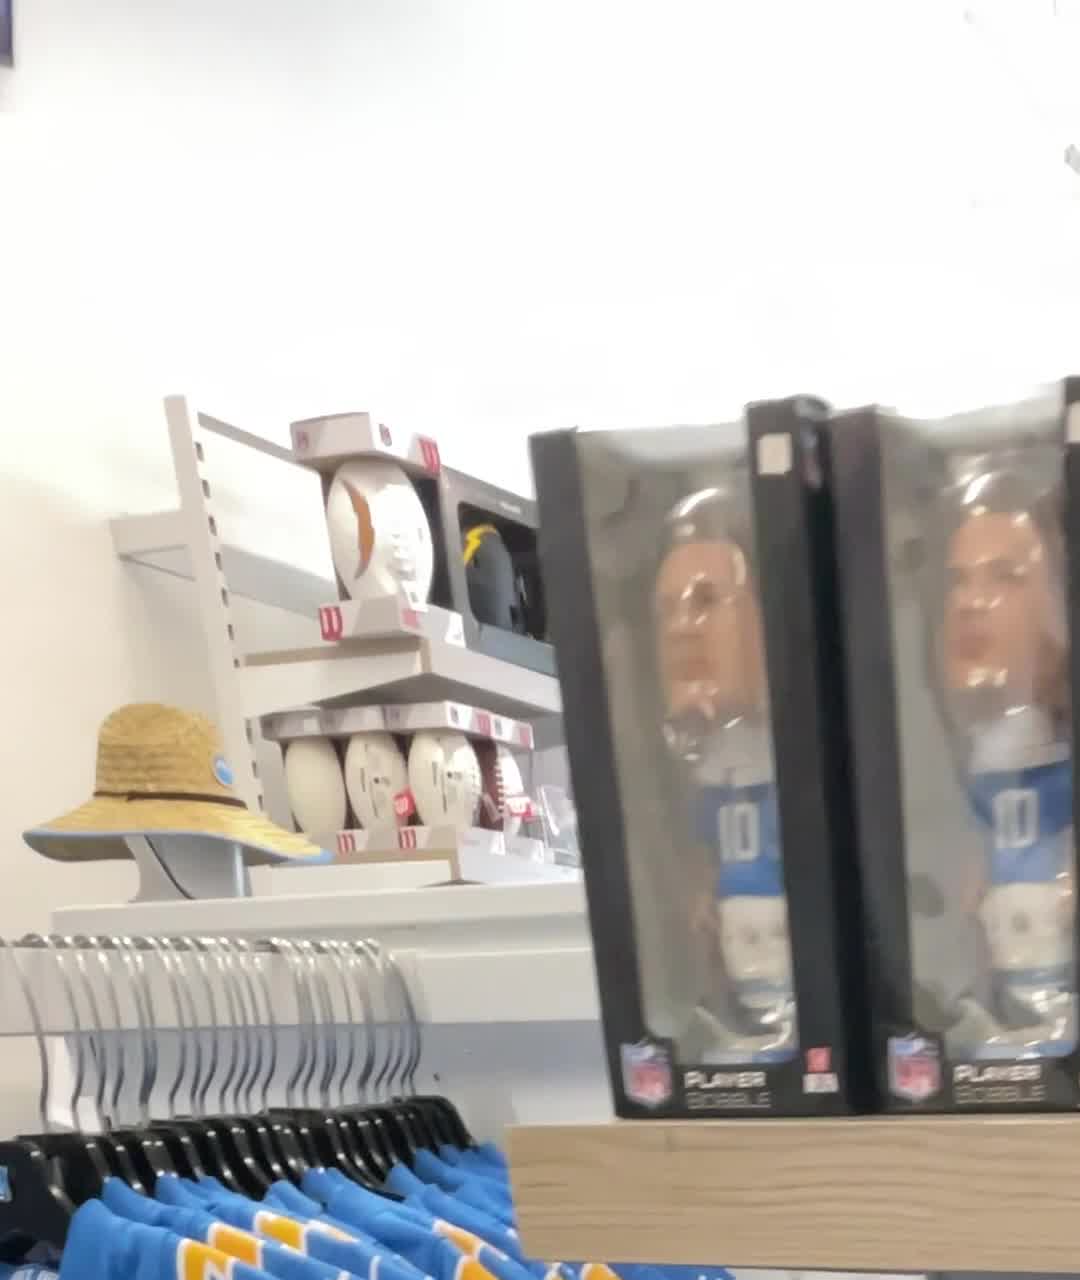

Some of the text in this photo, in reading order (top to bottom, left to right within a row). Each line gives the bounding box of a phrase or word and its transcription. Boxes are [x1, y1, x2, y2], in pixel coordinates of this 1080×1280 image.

[717, 802, 761, 864] 10
[683, 1071, 768, 1089] PLAYER
[953, 1063, 1043, 1083] PLAYER
